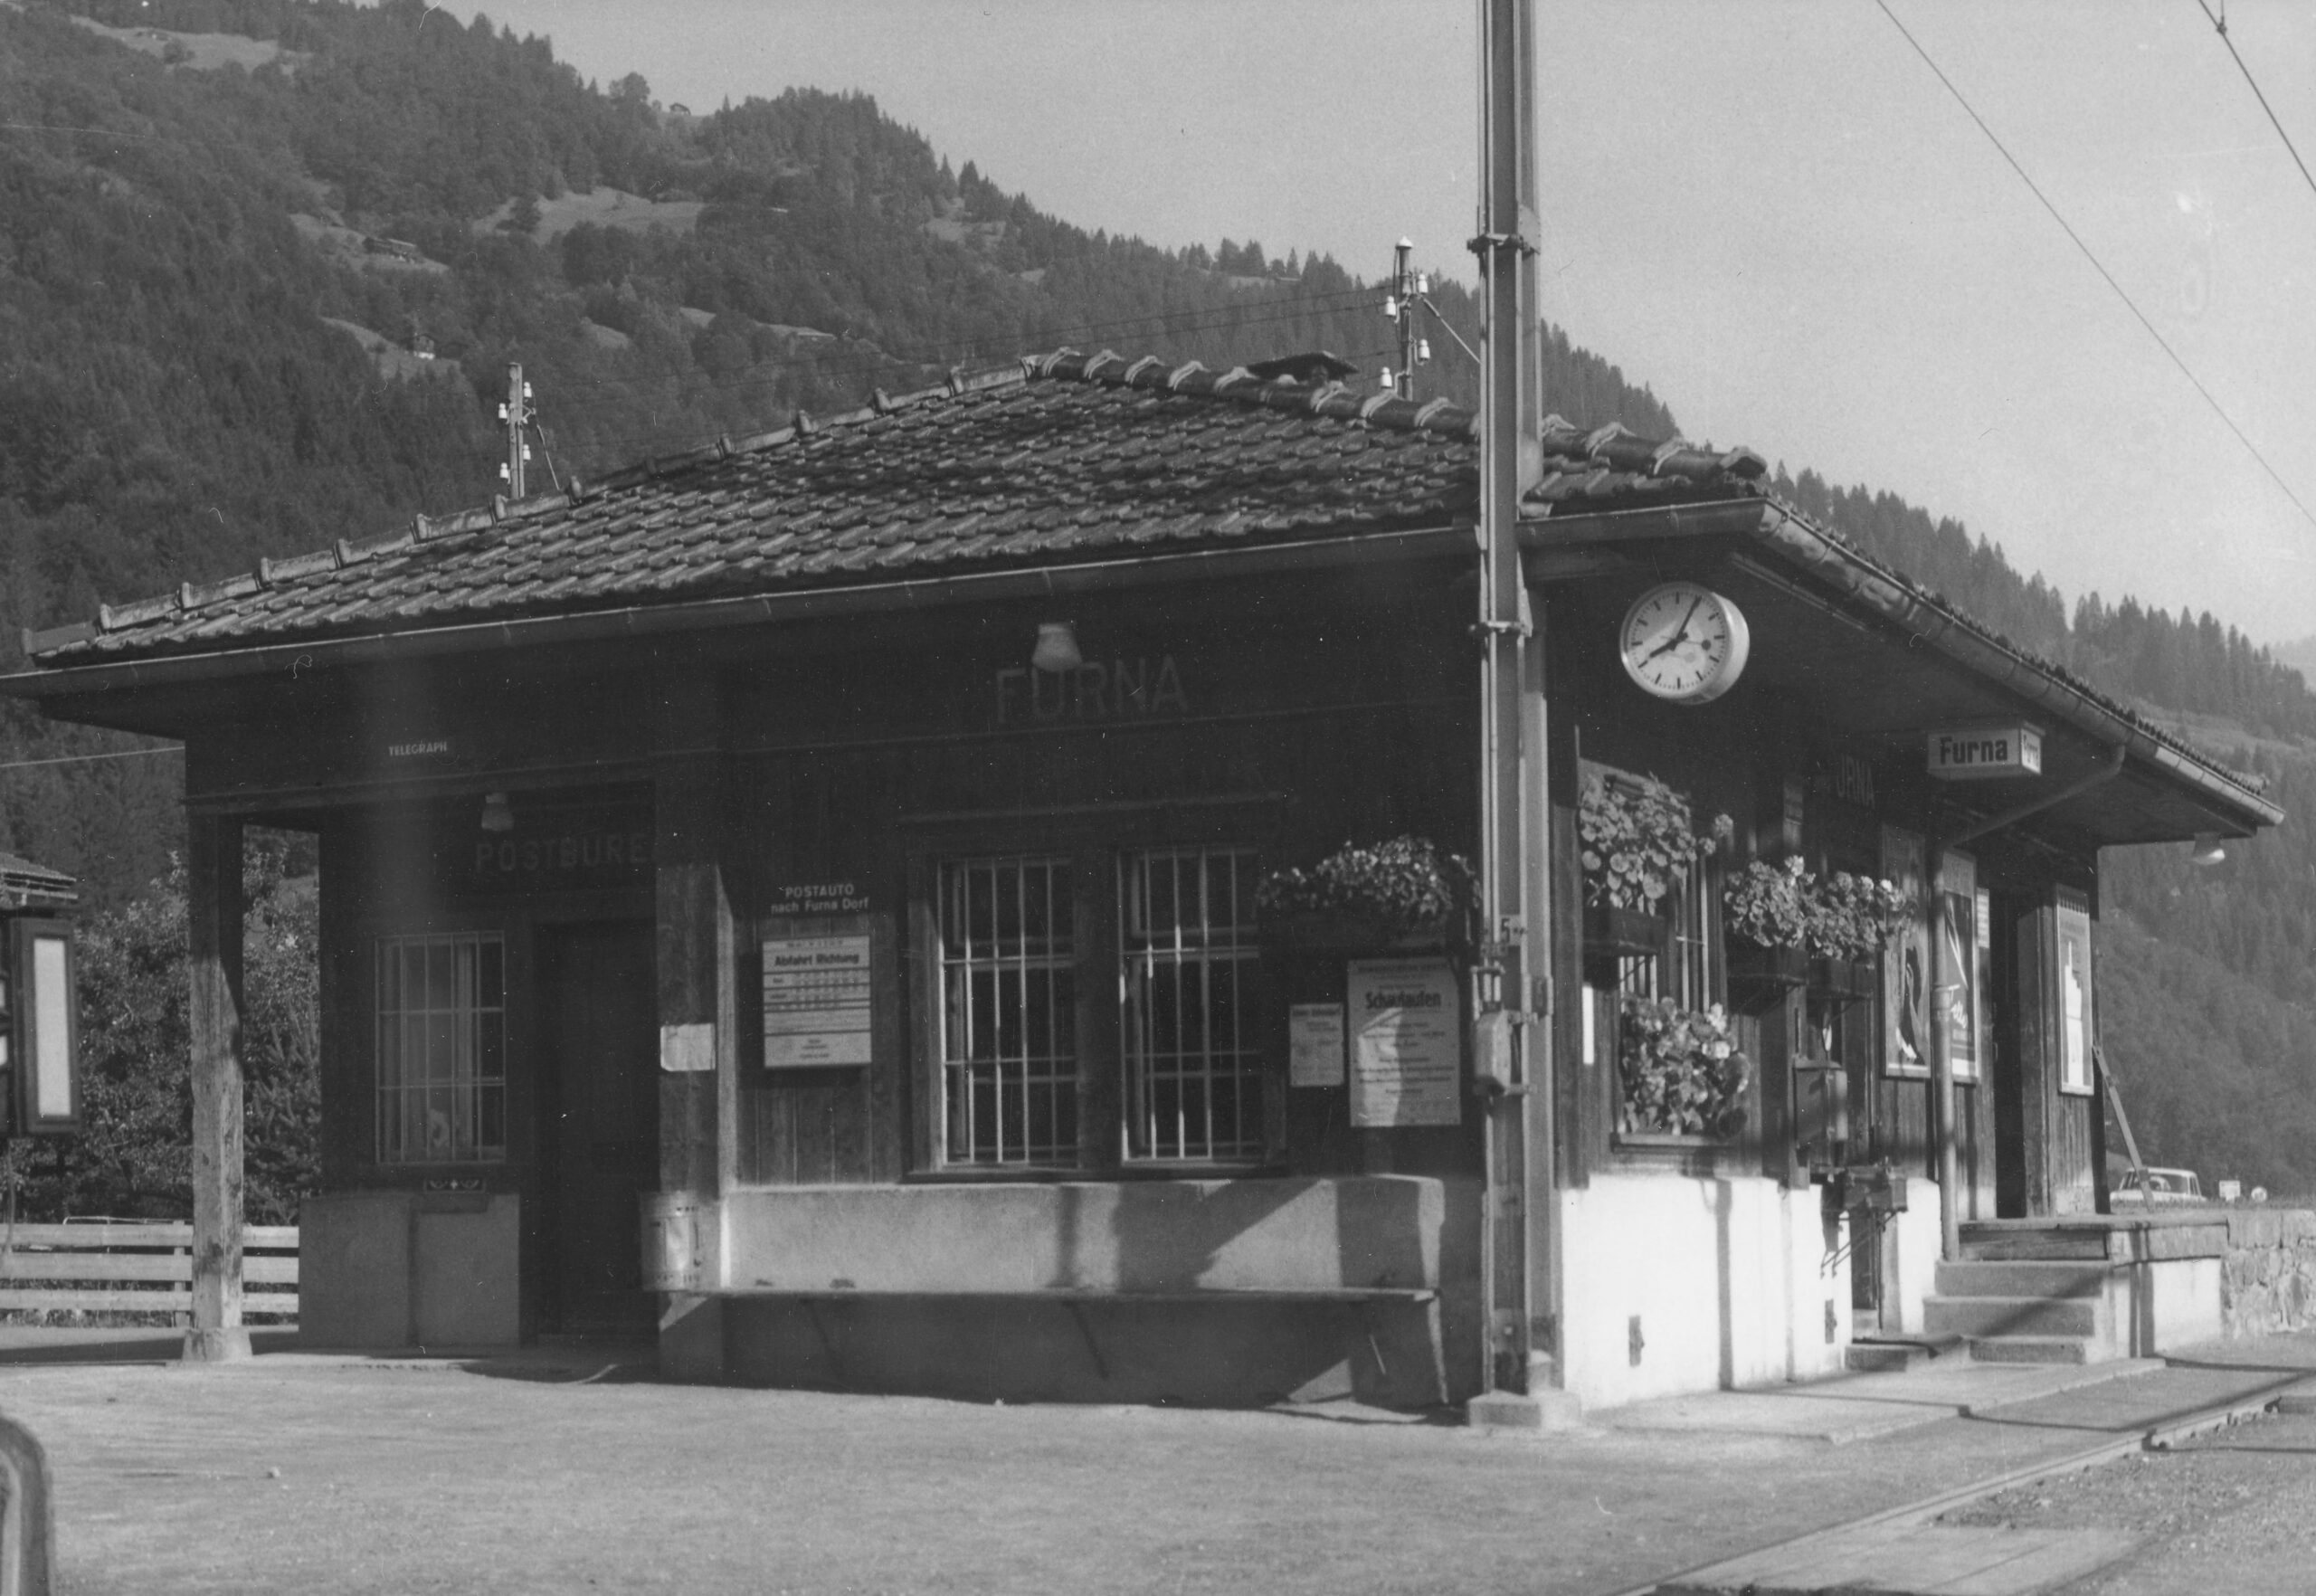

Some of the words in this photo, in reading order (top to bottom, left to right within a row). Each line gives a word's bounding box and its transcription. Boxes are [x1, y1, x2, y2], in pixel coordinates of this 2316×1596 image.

[997, 653, 1190, 724] FURNA
[387, 740, 448, 757] TELEGRAPH
[1939, 736, 2008, 765] Furna
[1835, 753, 1876, 812] URNA
[476, 832, 649, 874] POSTBURE
[784, 882, 855, 898] POSTAUTO
[771, 902, 800, 915] nach
[804, 898, 839, 912] Furna
[841, 896, 870, 910] Dorf
